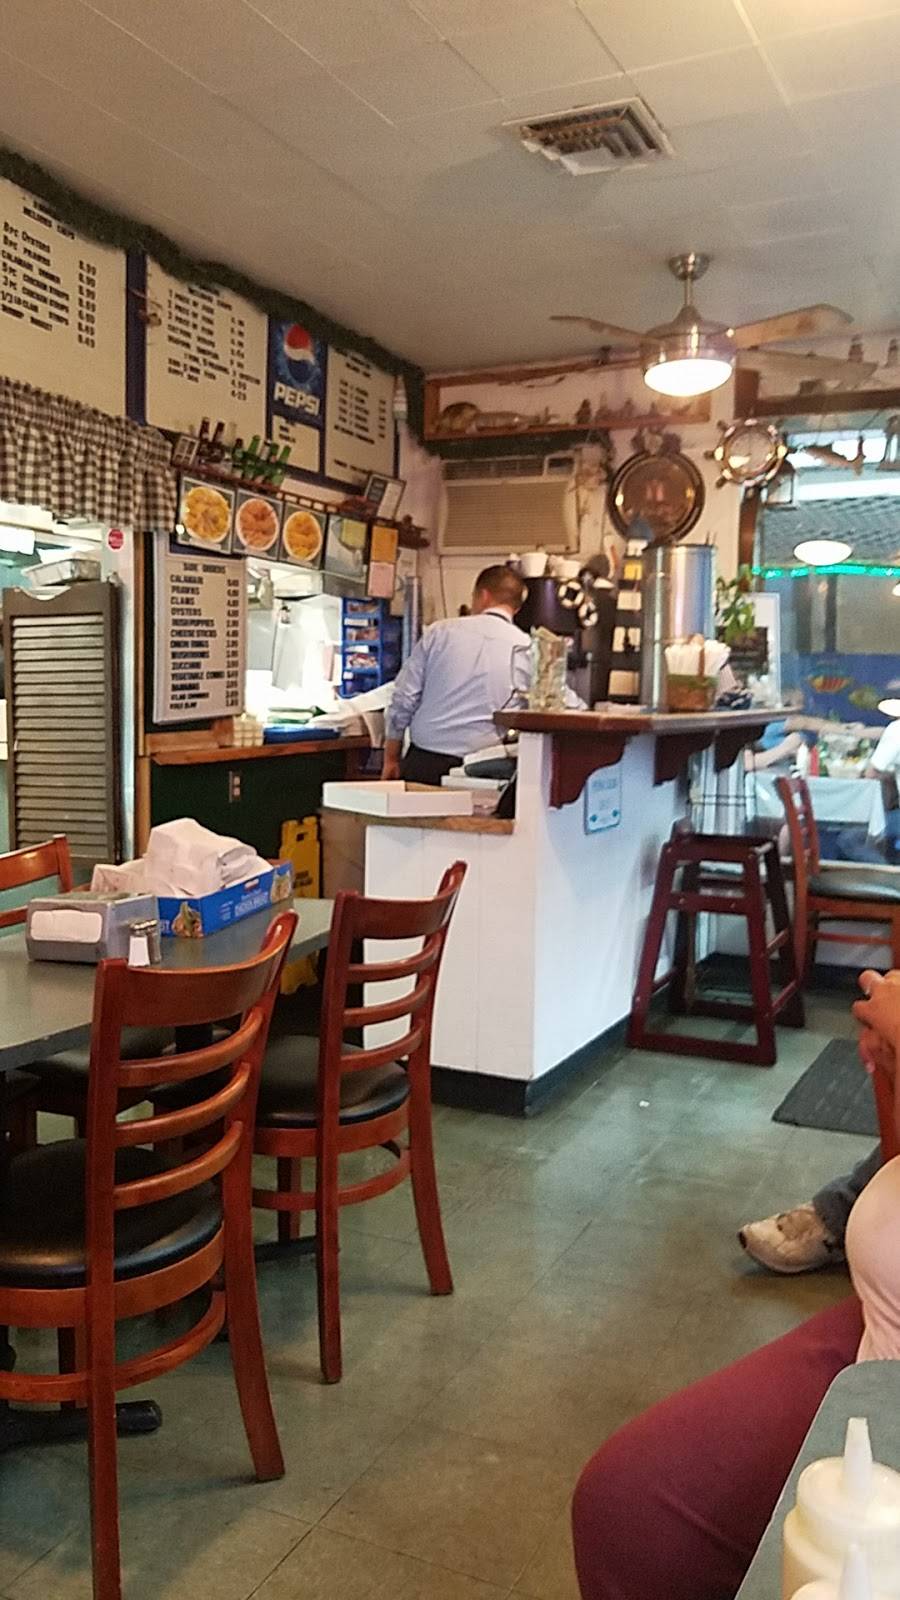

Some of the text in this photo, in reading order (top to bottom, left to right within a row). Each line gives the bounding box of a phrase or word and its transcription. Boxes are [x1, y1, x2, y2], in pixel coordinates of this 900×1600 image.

[274, 383, 320, 416] PEPSI
[170, 575, 203, 584] CALAMARI
[172, 586, 200, 595] PRAWNS
[171, 597, 194, 605] CLAMS
[171, 608, 202, 616] OYSTERS
